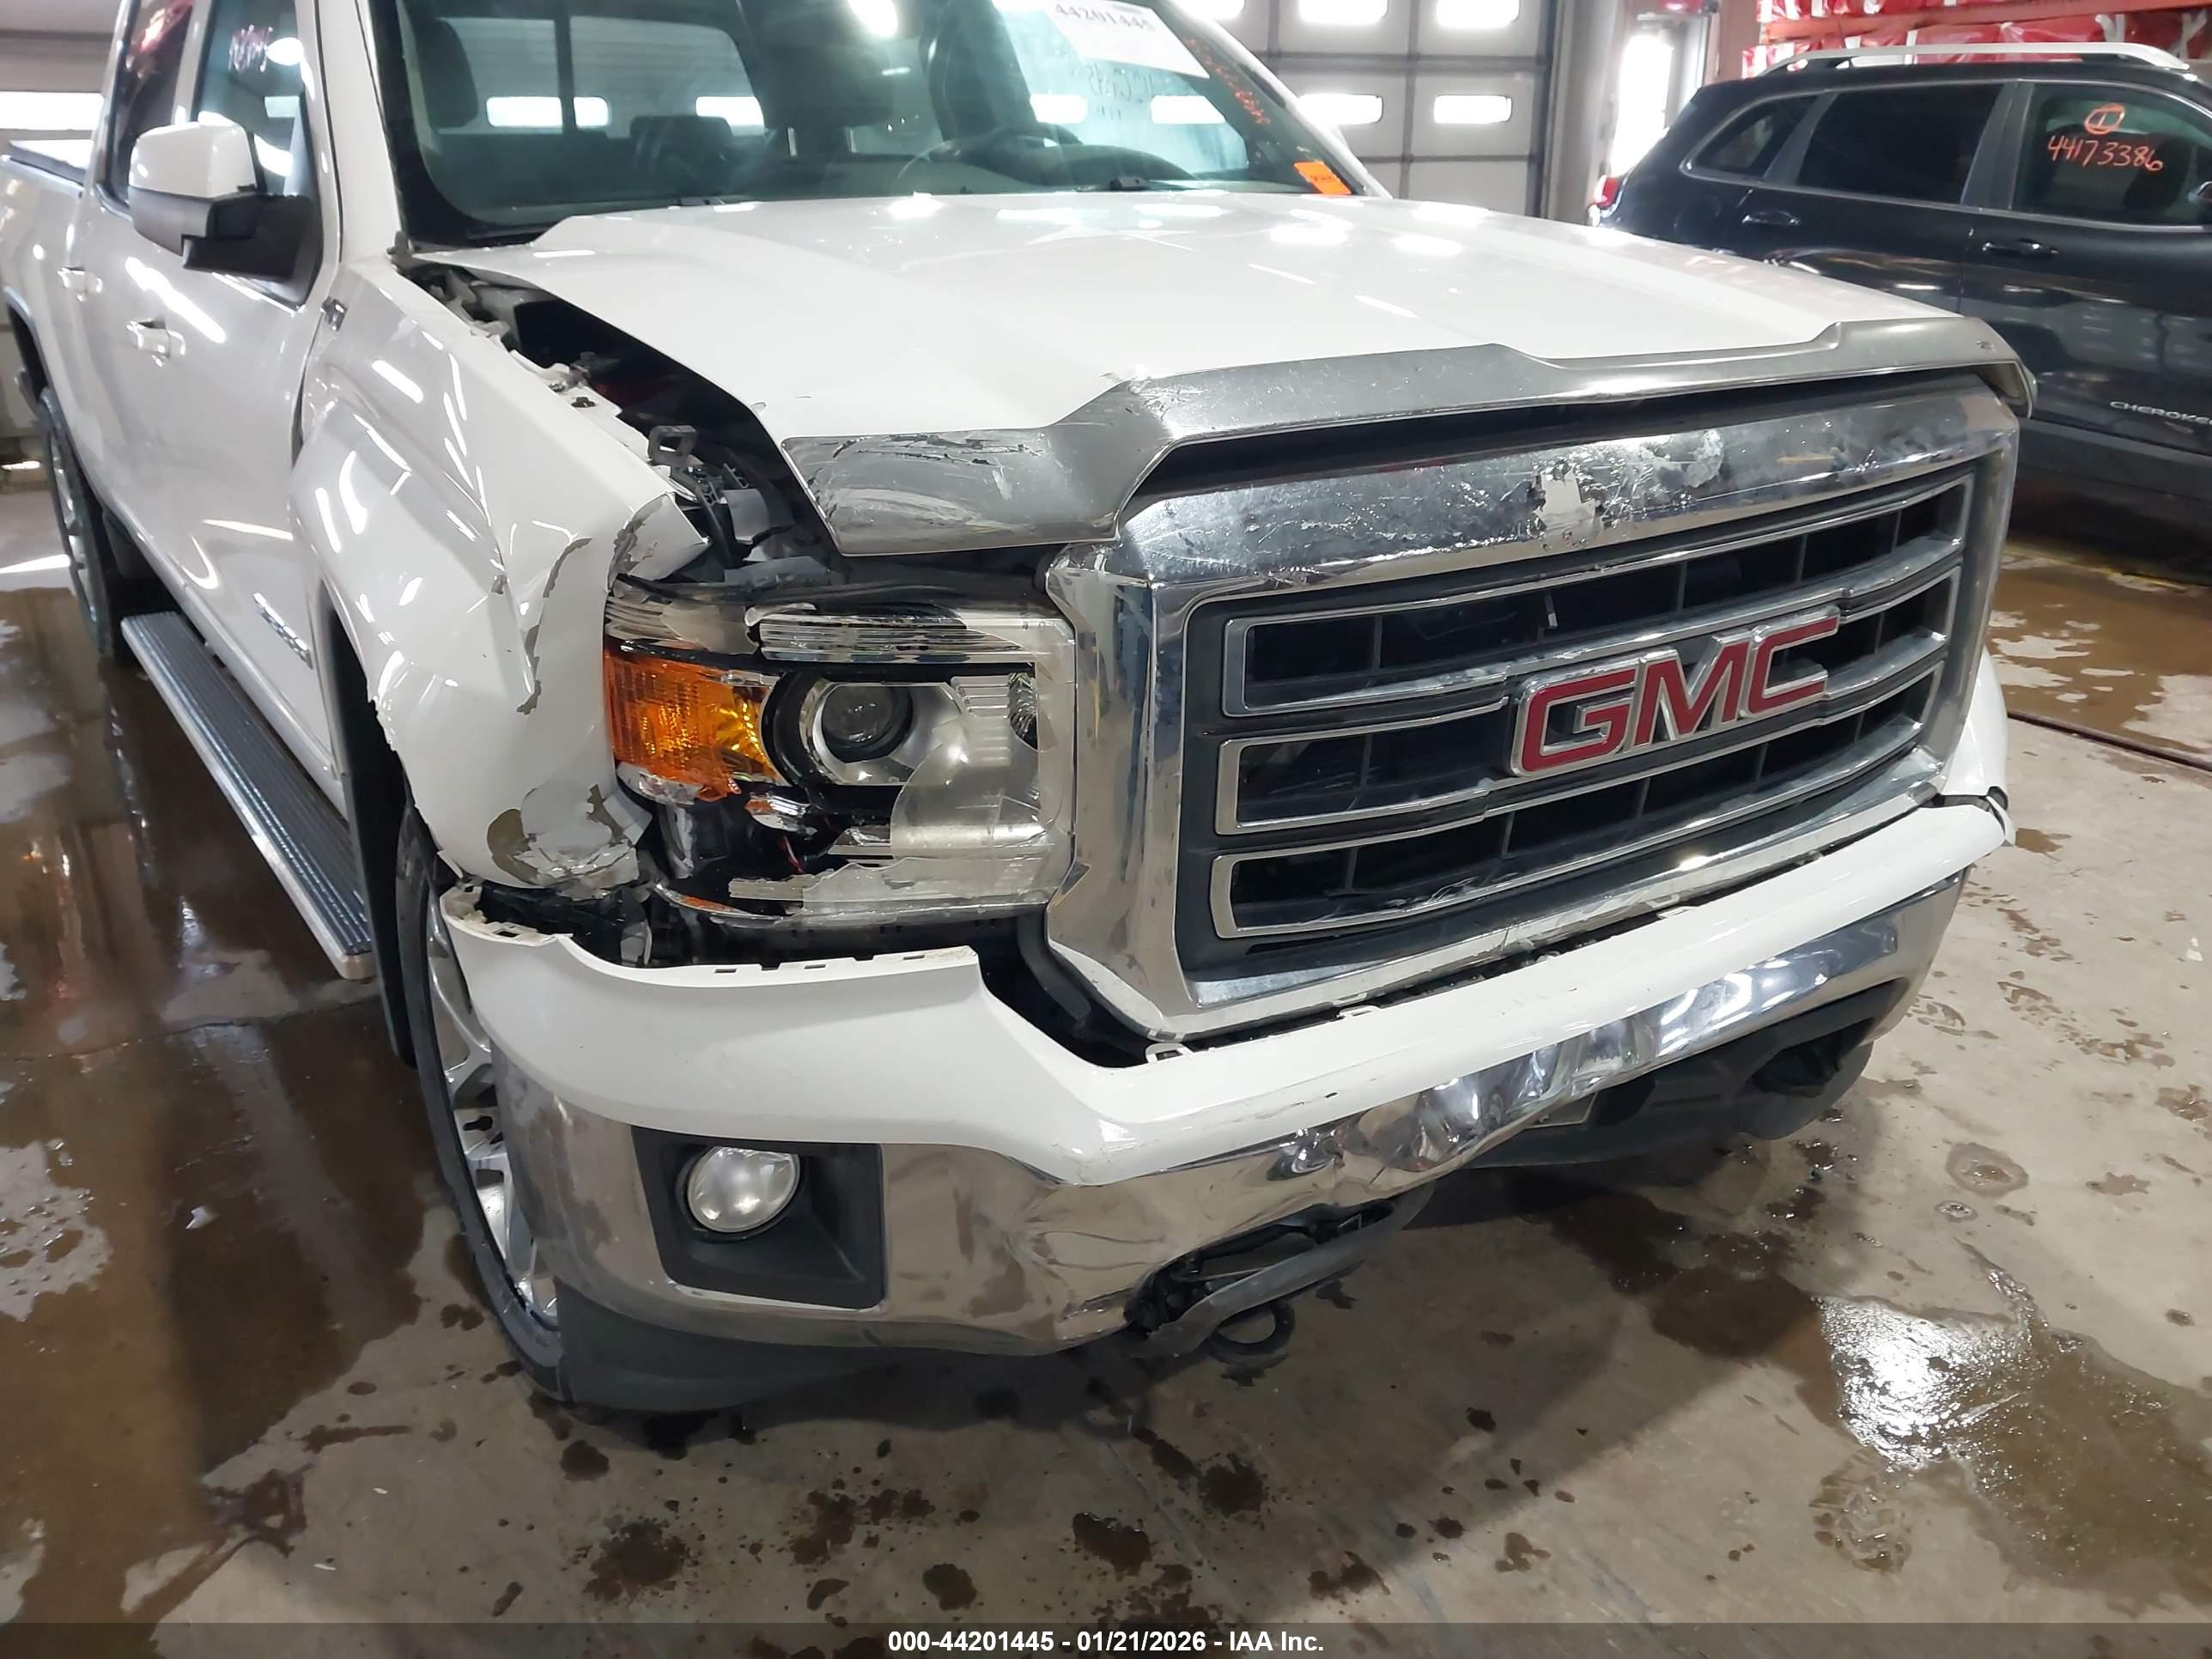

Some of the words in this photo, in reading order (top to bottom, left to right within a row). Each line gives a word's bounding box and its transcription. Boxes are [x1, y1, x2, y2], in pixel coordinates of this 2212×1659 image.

[2047, 135, 2164, 172] 44173386
[2109, 400, 2212, 426] CHEROKE
[1510, 605, 1840, 777] GMC
